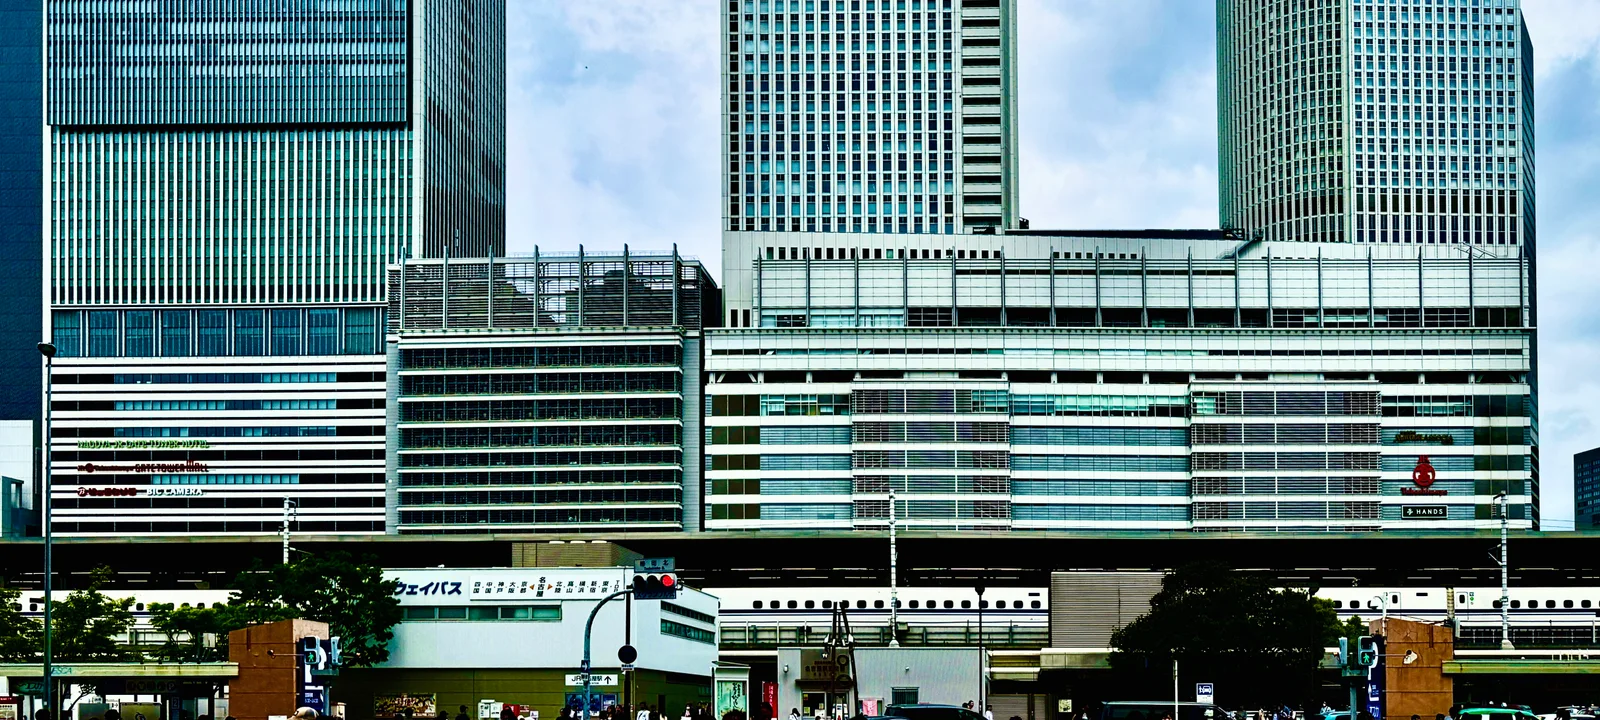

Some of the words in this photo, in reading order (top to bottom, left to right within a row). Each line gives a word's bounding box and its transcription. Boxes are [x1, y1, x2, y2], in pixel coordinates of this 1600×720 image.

[146, 488, 162, 497] BIC
[164, 488, 203, 497] CAMERA
[496, 581, 505, 594] 神戸
[507, 581, 516, 594] 大阪
[519, 581, 528, 594] 京都
[536, 576, 546, 597] 名古屋
[554, 581, 563, 594] 北陸
[566, 581, 574, 594] 高山
[578, 580, 586, 593] 横浜
[589, 580, 598, 593] 新宿
[601, 580, 610, 593] 東京
